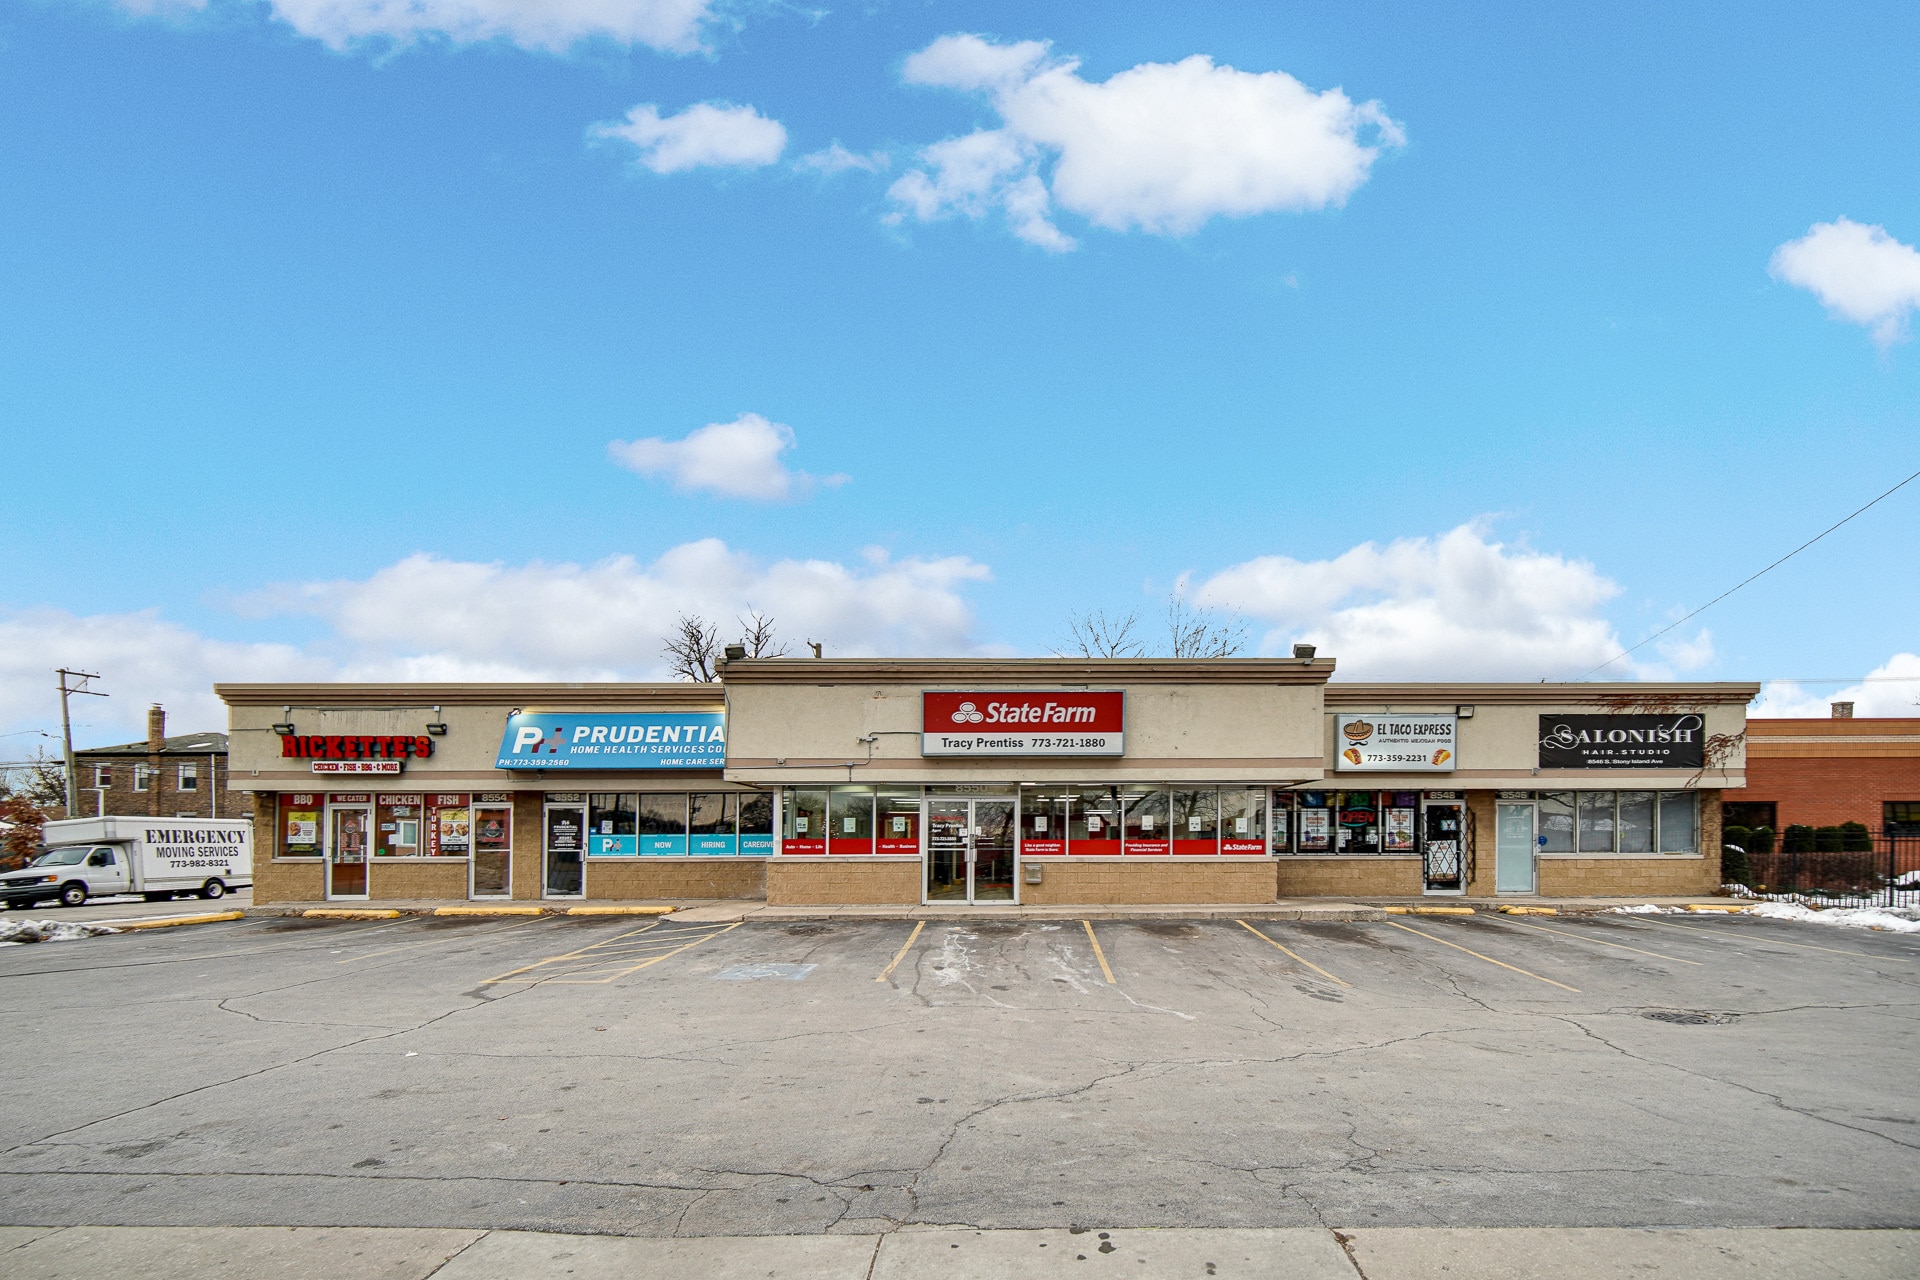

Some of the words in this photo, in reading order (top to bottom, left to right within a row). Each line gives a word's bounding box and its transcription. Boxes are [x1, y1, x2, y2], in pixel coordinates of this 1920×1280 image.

[985, 702, 1096, 723] StateFarm
[572, 725, 725, 743] PRUDENTIA
[1377, 723, 1387, 735] EL
[1389, 723, 1412, 735] TACO
[1413, 723, 1452, 735] EXPRESS
[281, 735, 430, 758] RICKETTE'S
[941, 737, 973, 750] Tracy
[976, 737, 1024, 748] Prentiss
[1031, 738, 1106, 748] 773-721-1880
[570, 745, 600, 754] HOME
[603, 745, 648, 754] HEALTH
[650, 745, 705, 754] SERVICES
[707, 745, 725, 754] CO
[498, 758, 569, 767] PH:773-359-2560
[660, 758, 684, 766] HOME
[1367, 754, 1427, 762] 773-359-2231
[343, 763, 356, 771] FISH
[381, 763, 398, 771] MORE
[955, 785, 988, 793] 8550
[293, 794, 313, 805] BBQ
[379, 794, 421, 805] CHICKEN
[437, 794, 459, 805] FISH
[481, 793, 507, 802] 8554
[554, 793, 580, 801] 8552
[1430, 791, 1456, 799] 8548
[1502, 791, 1528, 799] 8546
[1339, 811, 1376, 822] OPEN
[145, 829, 246, 844] EMERGENCY
[156, 846, 195, 858] MOVING
[197, 846, 239, 857] SERVICES
[170, 859, 229, 868] 773-982-8321
